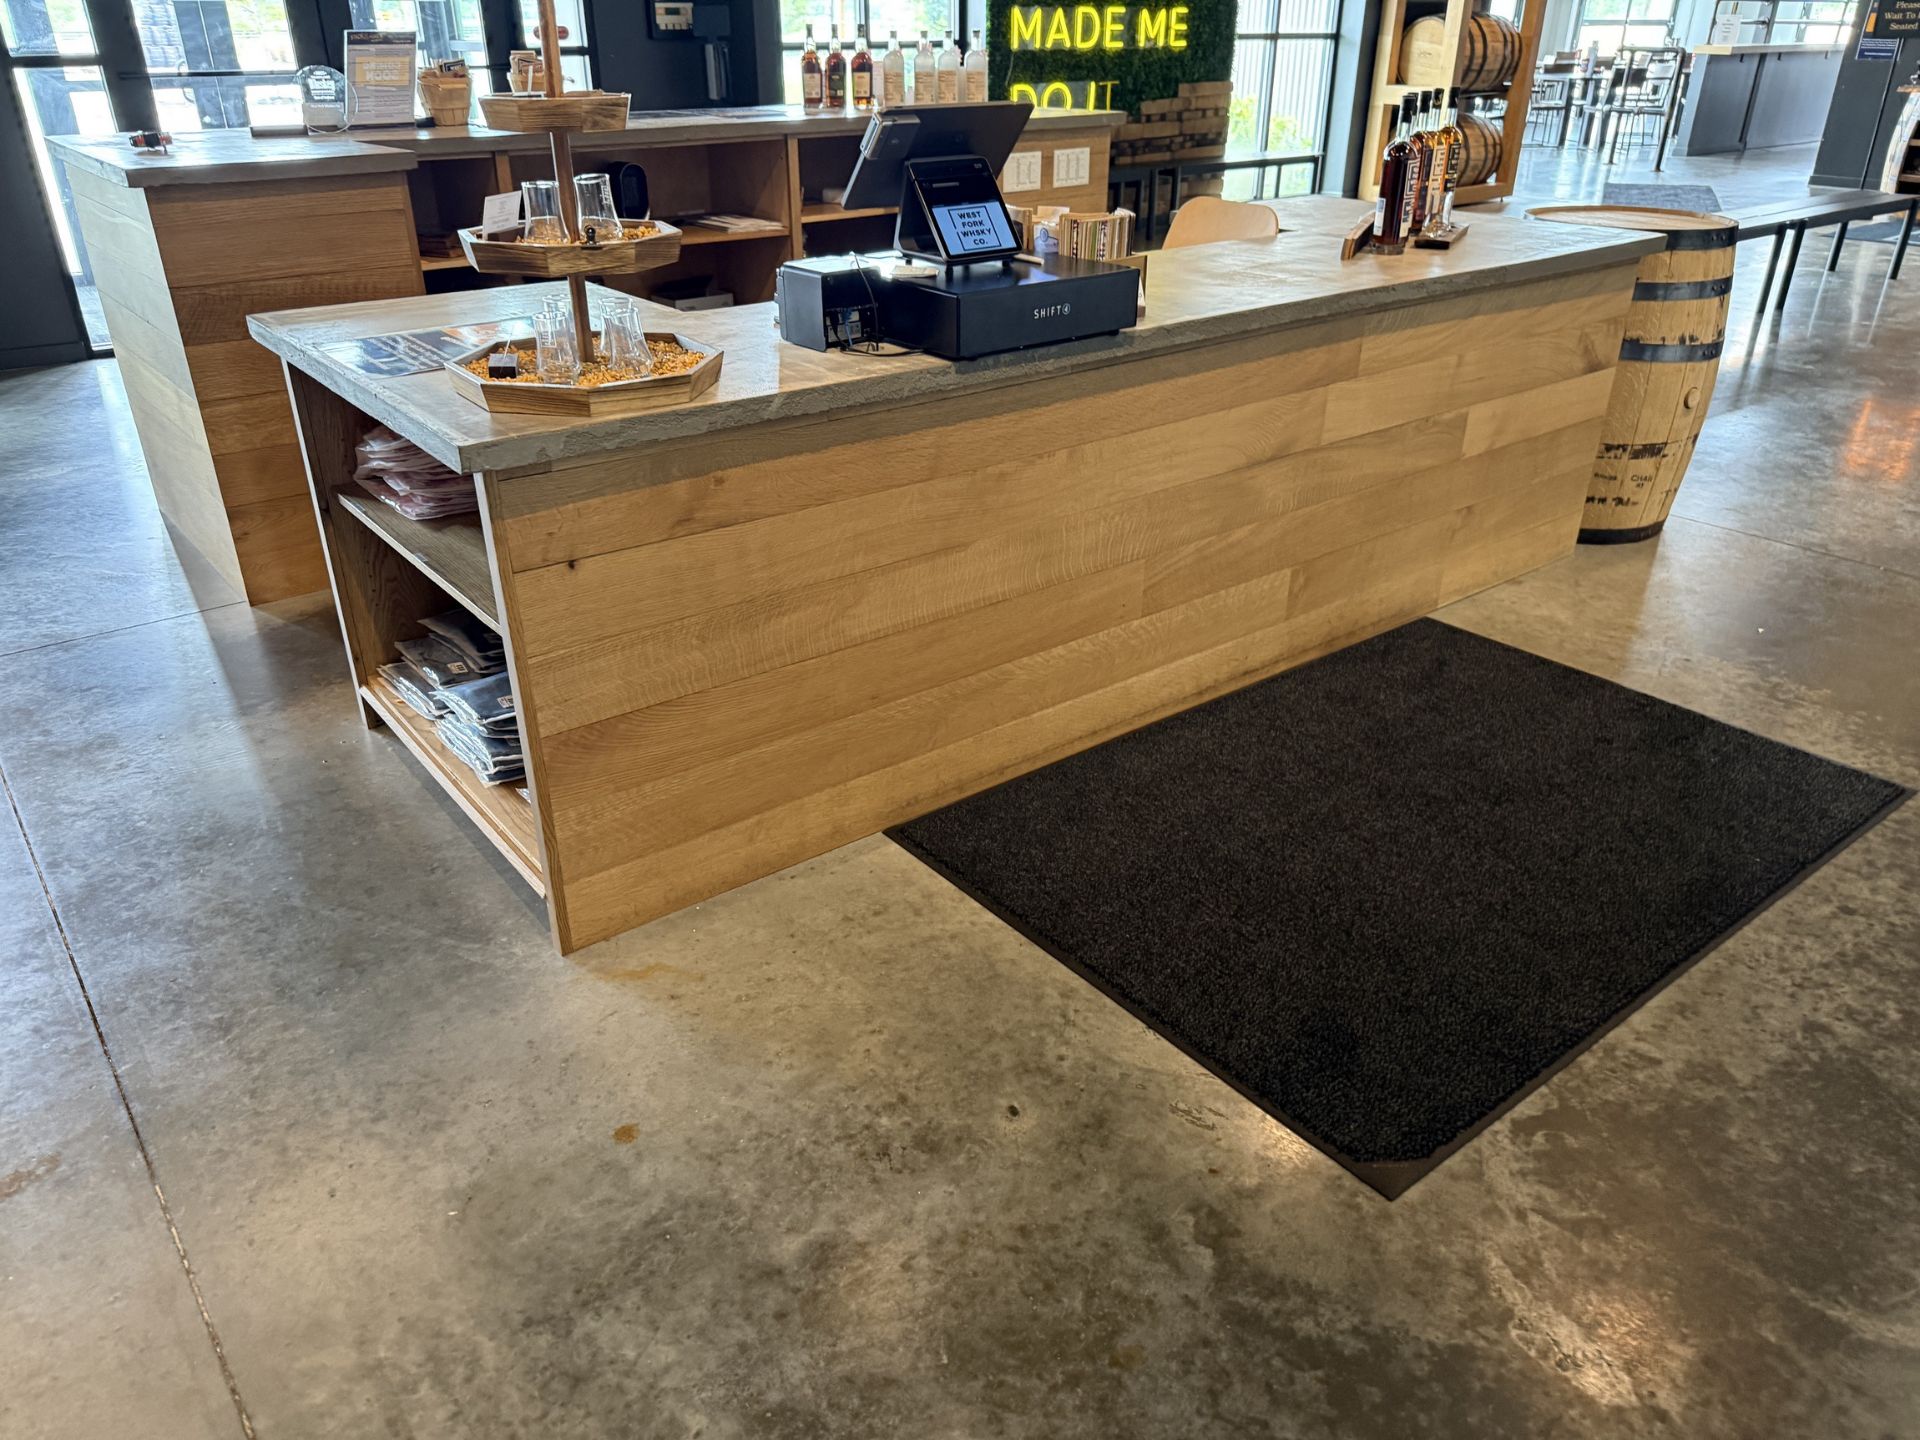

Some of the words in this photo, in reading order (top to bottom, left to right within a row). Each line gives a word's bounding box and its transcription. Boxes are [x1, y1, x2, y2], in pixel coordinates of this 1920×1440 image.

[1906, 11, 1916, 19] To
[1011, 6, 1126, 49] MADE
[1138, 7, 1189, 48] ME
[1889, 22, 1918, 30] Seated
[957, 211, 981, 220] WEST
[961, 219, 985, 228] FORK
[961, 228, 992, 238] WHSKY
[973, 238, 989, 246] CO.
